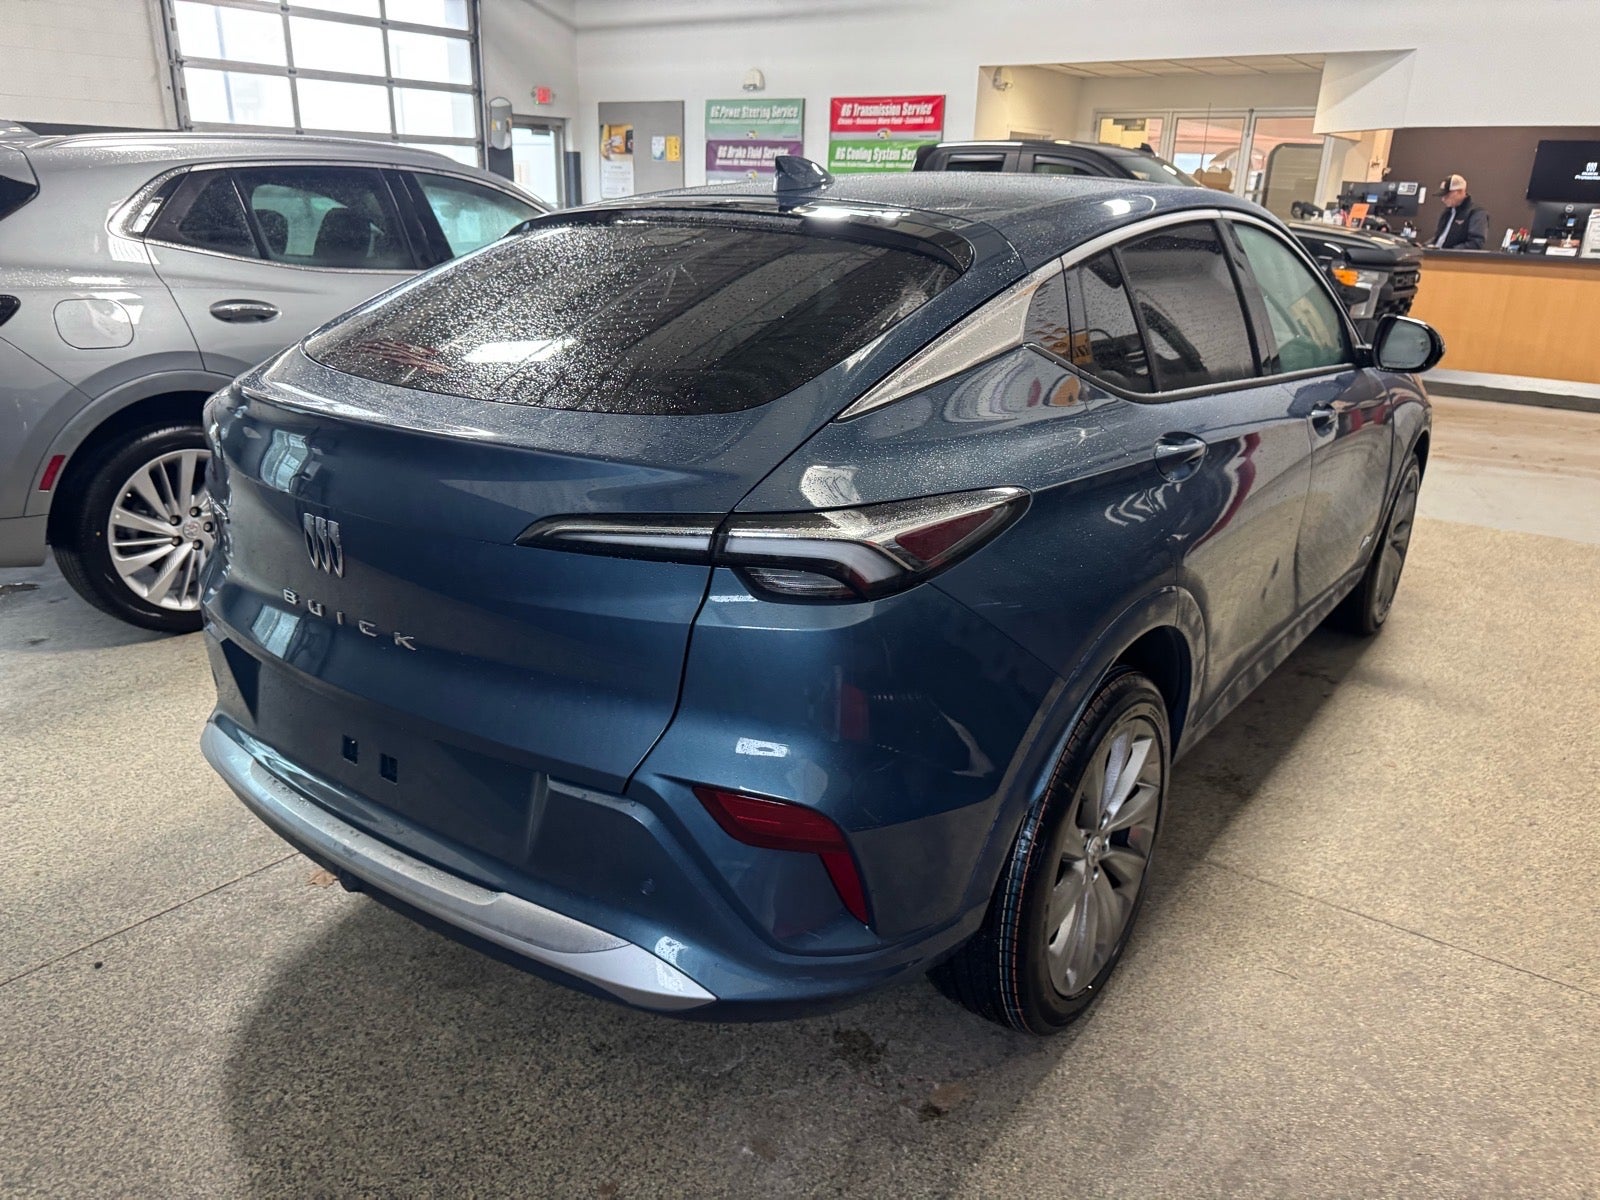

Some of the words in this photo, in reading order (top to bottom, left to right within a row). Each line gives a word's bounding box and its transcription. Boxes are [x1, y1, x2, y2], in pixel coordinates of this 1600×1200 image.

[720, 105, 741, 118] Power
[741, 105, 771, 120] Steering
[772, 105, 799, 118] Service
[853, 102, 901, 117] Transmission
[901, 102, 934, 116] Service
[727, 145, 747, 159] Brake
[747, 146, 763, 159] Fluid
[846, 147, 873, 163] Cooling
[872, 146, 901, 163] System
[282, 587, 417, 651] BUICK
